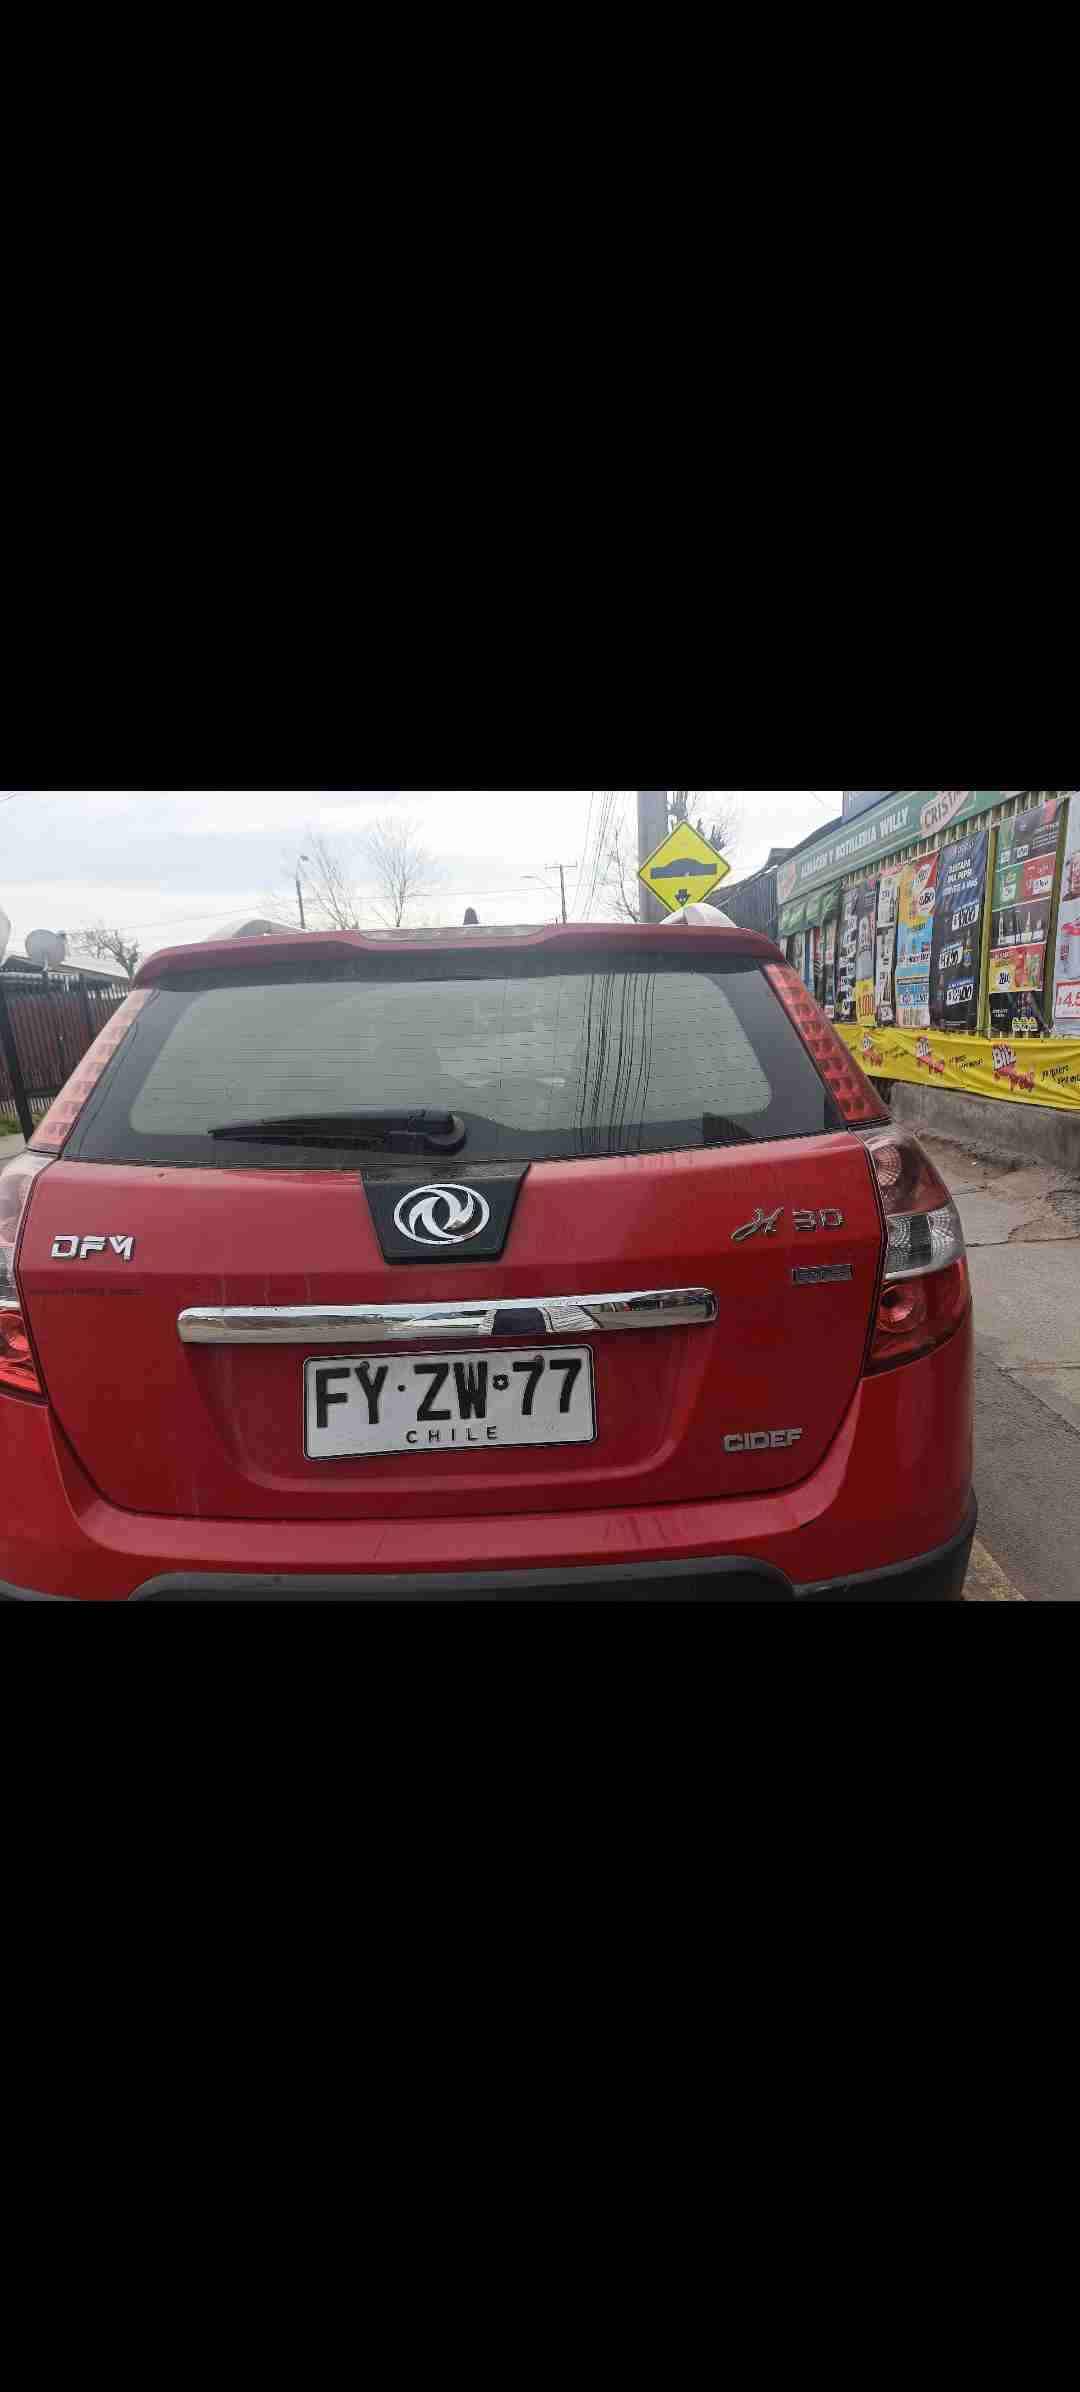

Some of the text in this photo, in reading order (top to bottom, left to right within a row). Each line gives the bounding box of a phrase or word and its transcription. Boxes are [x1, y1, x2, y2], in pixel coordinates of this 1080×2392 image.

[879, 806, 910, 838] WILLY
[51, 1235, 134, 1262] DFM
[406, 1425, 498, 1444] CHILE
[723, 1427, 803, 1452] CIDEF
